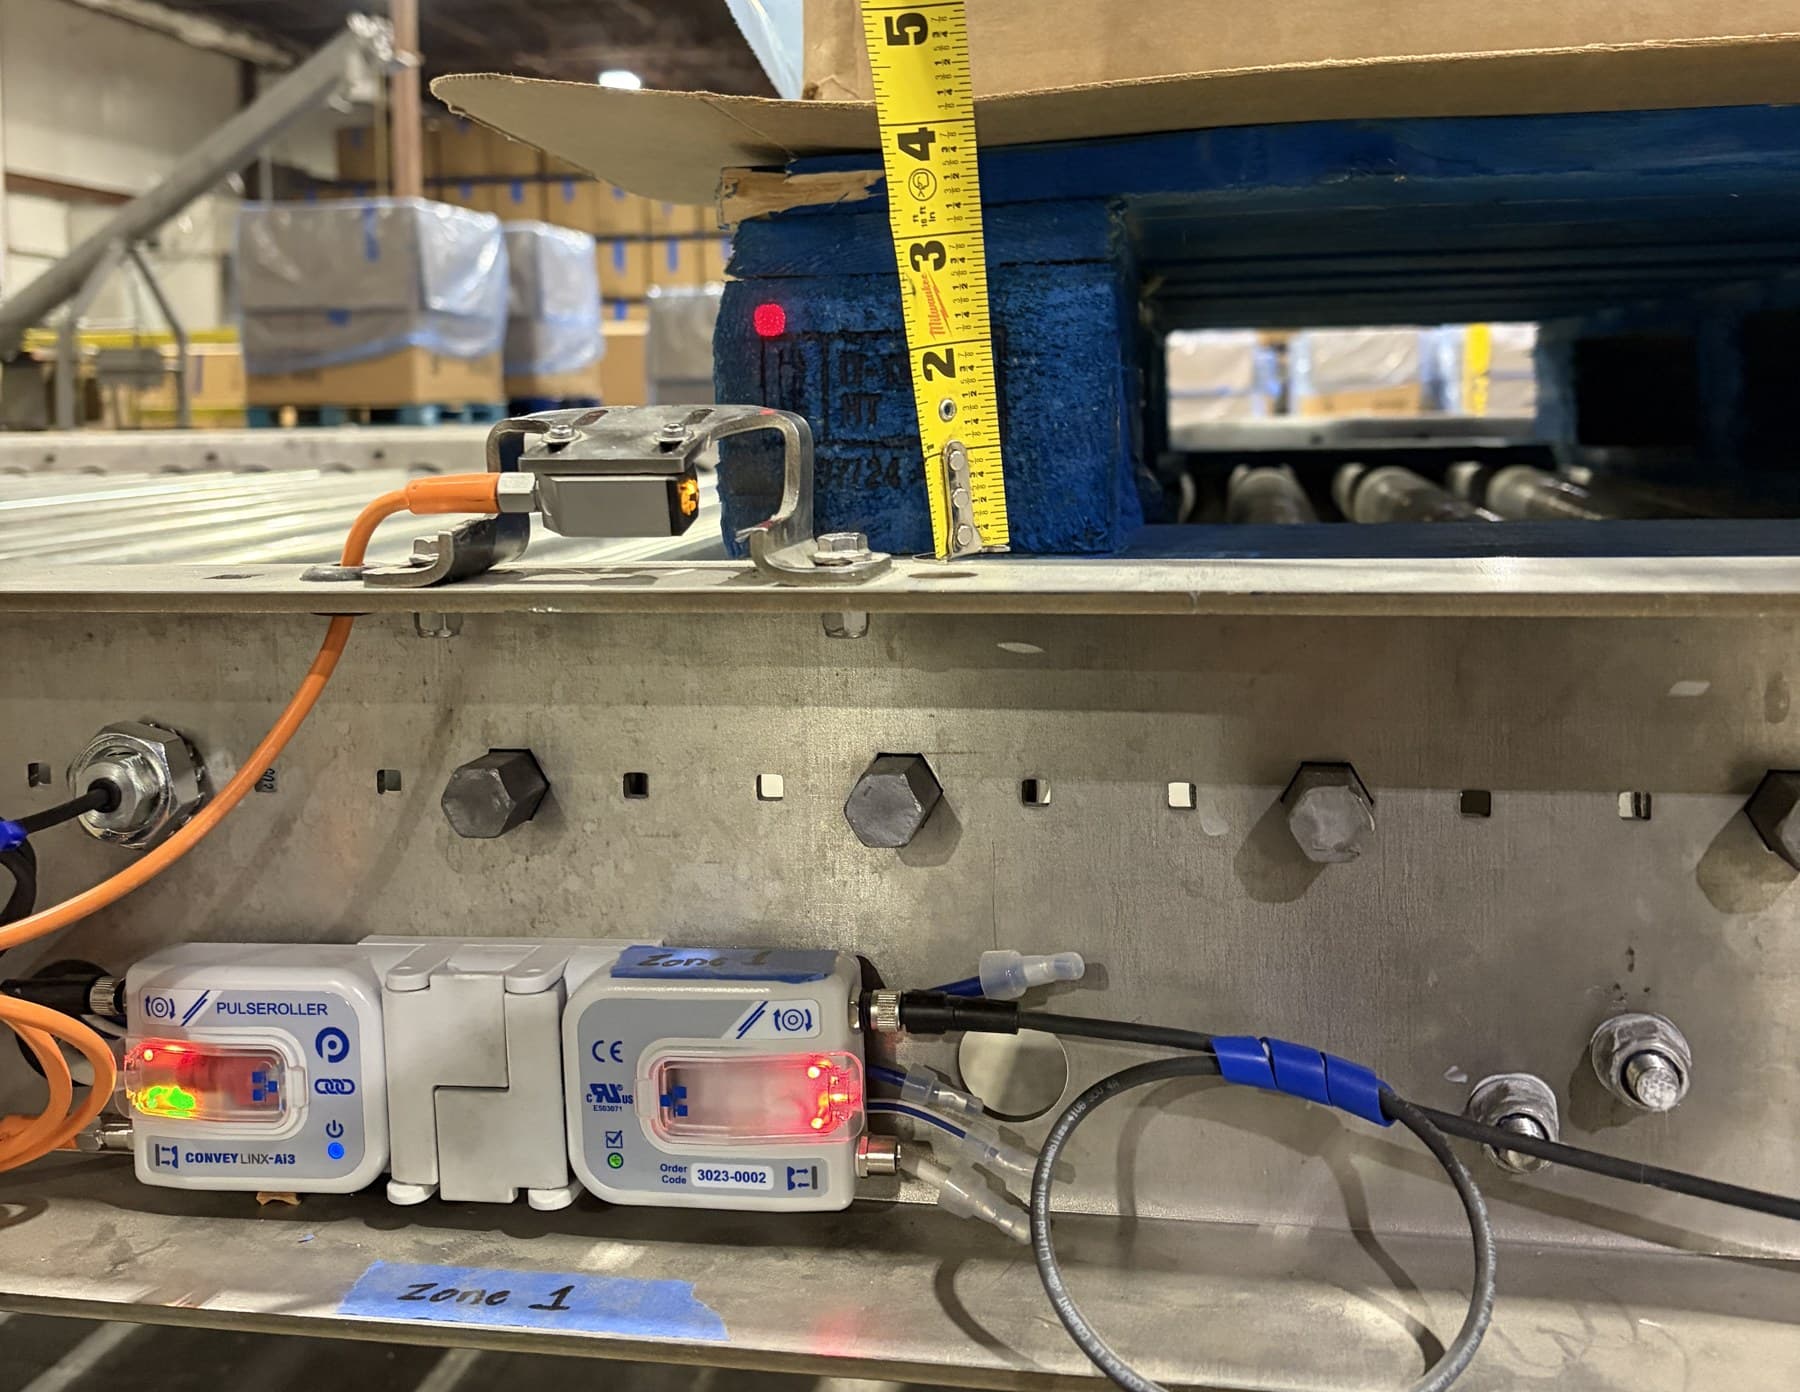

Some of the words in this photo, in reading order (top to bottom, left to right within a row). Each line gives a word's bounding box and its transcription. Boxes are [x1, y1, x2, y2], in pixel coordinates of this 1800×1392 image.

[884, 12, 929, 46] 5
[897, 127, 936, 161] 4
[909, 240, 947, 272] 3
[921, 273, 946, 338] Milwaukee
[922, 348, 957, 382] 2
[637, 953, 729, 968] Zone
[216, 1002, 329, 1016] PULSEROLLER
[592, 1040, 624, 1063] CE
[660, 1163, 688, 1174] Order
[661, 1175, 687, 1185] Code
[697, 1169, 767, 1184] 3023-0002
[1036, 1184, 1047, 1214] cable
[1035, 1220, 1051, 1261] Listed
[396, 1282, 511, 1306] Zone
[528, 1285, 575, 1311] 1
